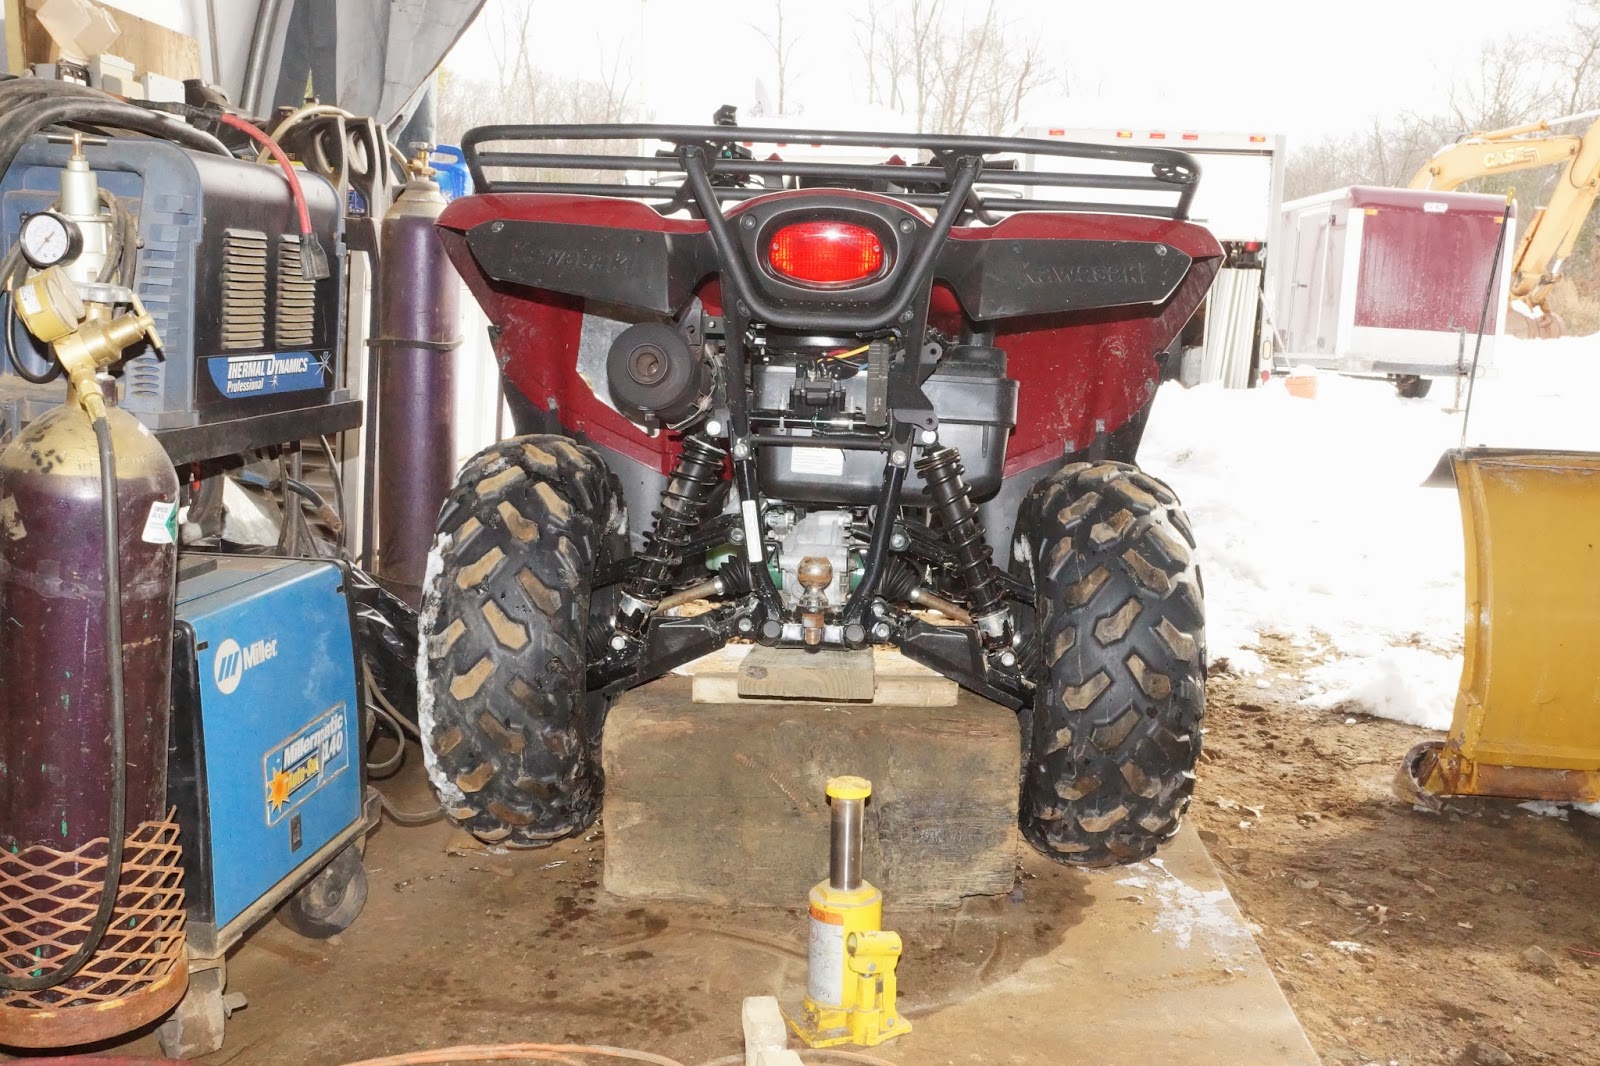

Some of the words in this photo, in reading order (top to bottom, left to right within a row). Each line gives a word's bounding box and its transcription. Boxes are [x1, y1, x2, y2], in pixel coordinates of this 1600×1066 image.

[227, 355, 266, 379] THERMAL
[265, 354, 309, 376] DYNAMICS
[227, 378, 264, 393] Professional
[242, 639, 278, 671] Miller
[282, 713, 344, 770] Millermatic
